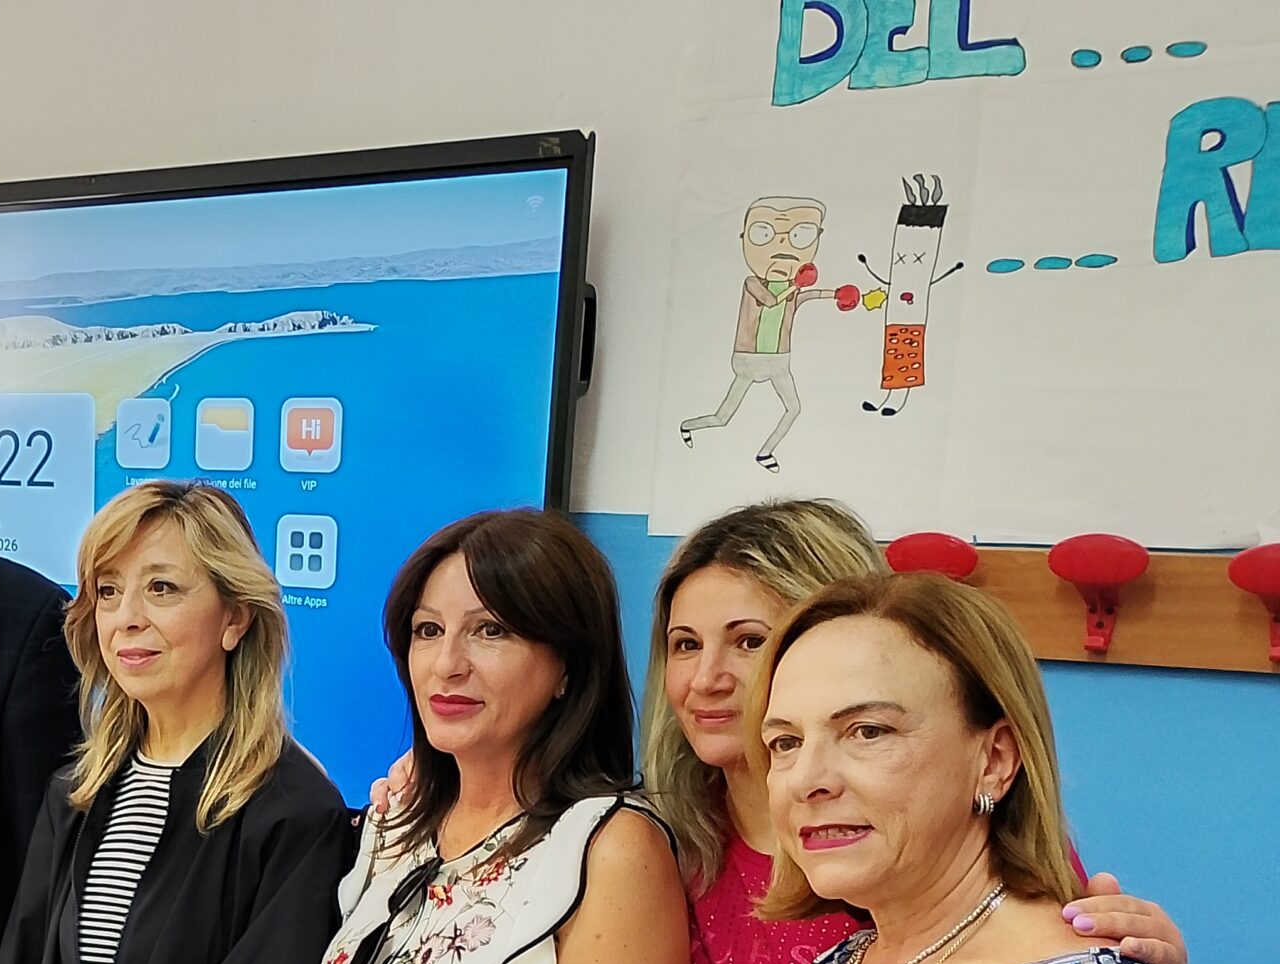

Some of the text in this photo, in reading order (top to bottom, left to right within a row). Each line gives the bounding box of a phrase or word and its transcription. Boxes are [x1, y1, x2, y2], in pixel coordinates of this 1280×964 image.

[771, 0, 1027, 107] DEL
[1151, 96, 1280, 264] R
[301, 418, 321, 440] Hi
[228, 476, 242, 490] dei
[243, 477, 257, 490] file
[300, 479, 318, 491] VIP
[281, 593, 328, 609] Altre Apps
